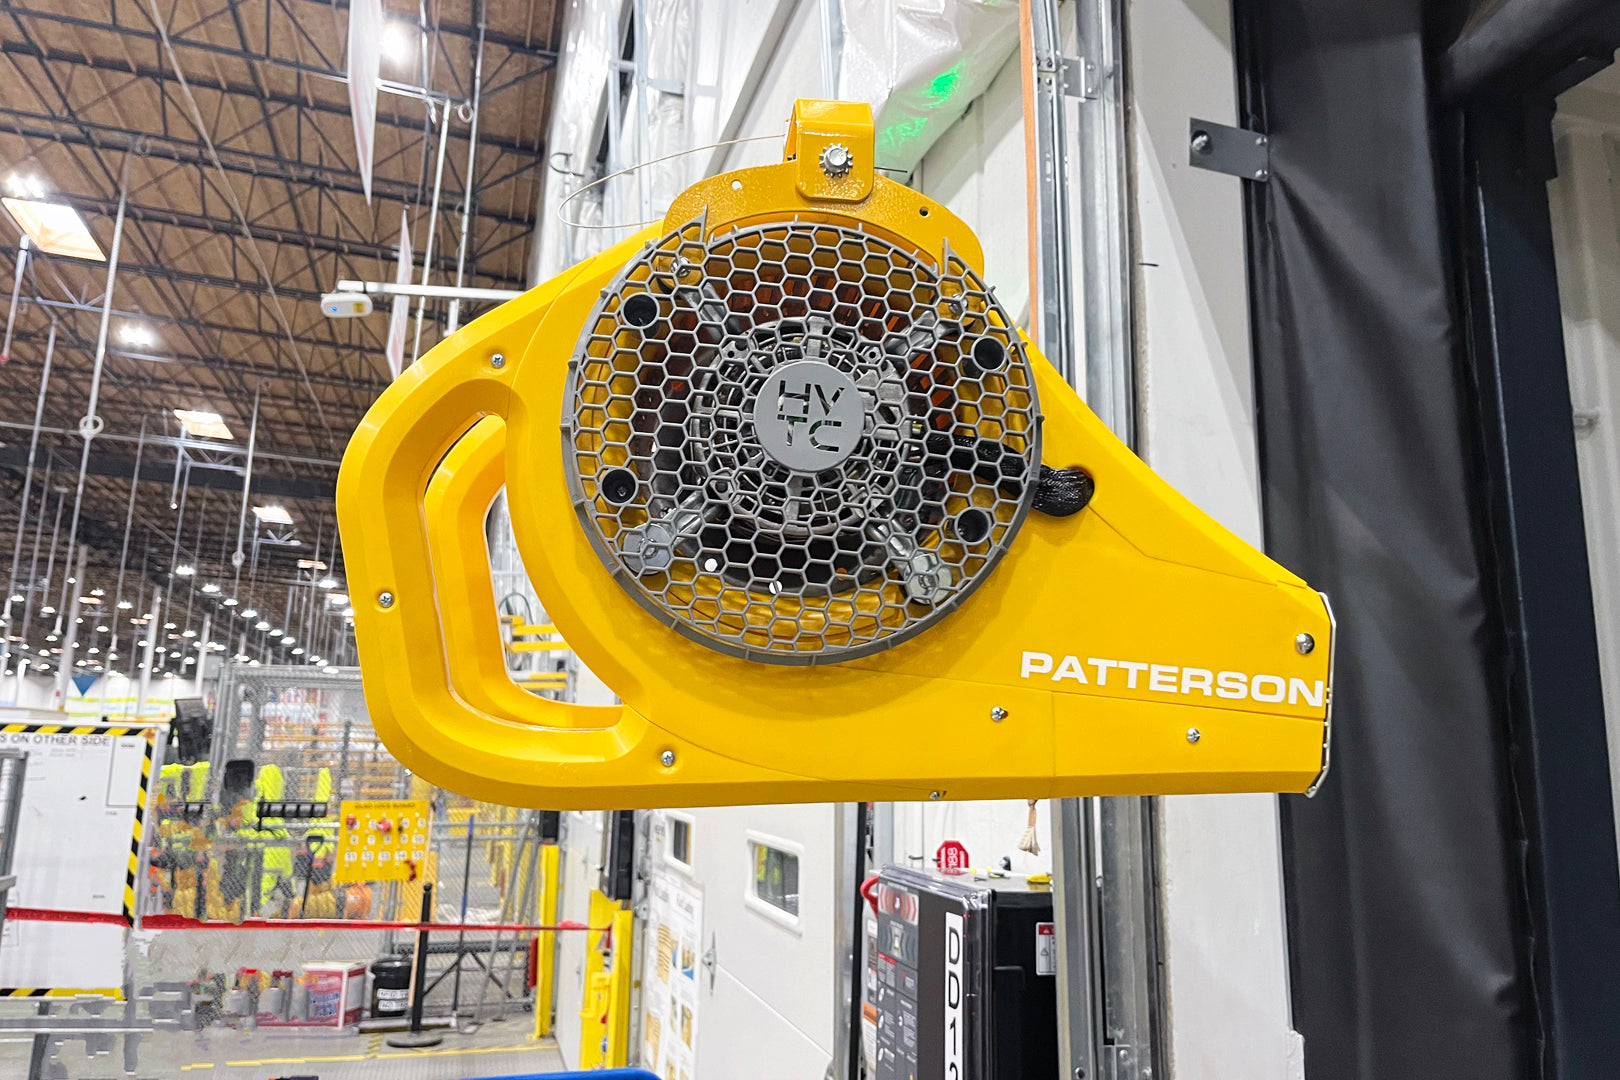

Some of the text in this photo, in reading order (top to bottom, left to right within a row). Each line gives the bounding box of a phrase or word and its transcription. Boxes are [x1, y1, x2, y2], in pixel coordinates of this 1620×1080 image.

[1020, 650, 1325, 707] PATTERSON
[10, 733, 29, 743] ON
[33, 733, 77, 745] OTHER
[81, 735, 110, 746] SIDE
